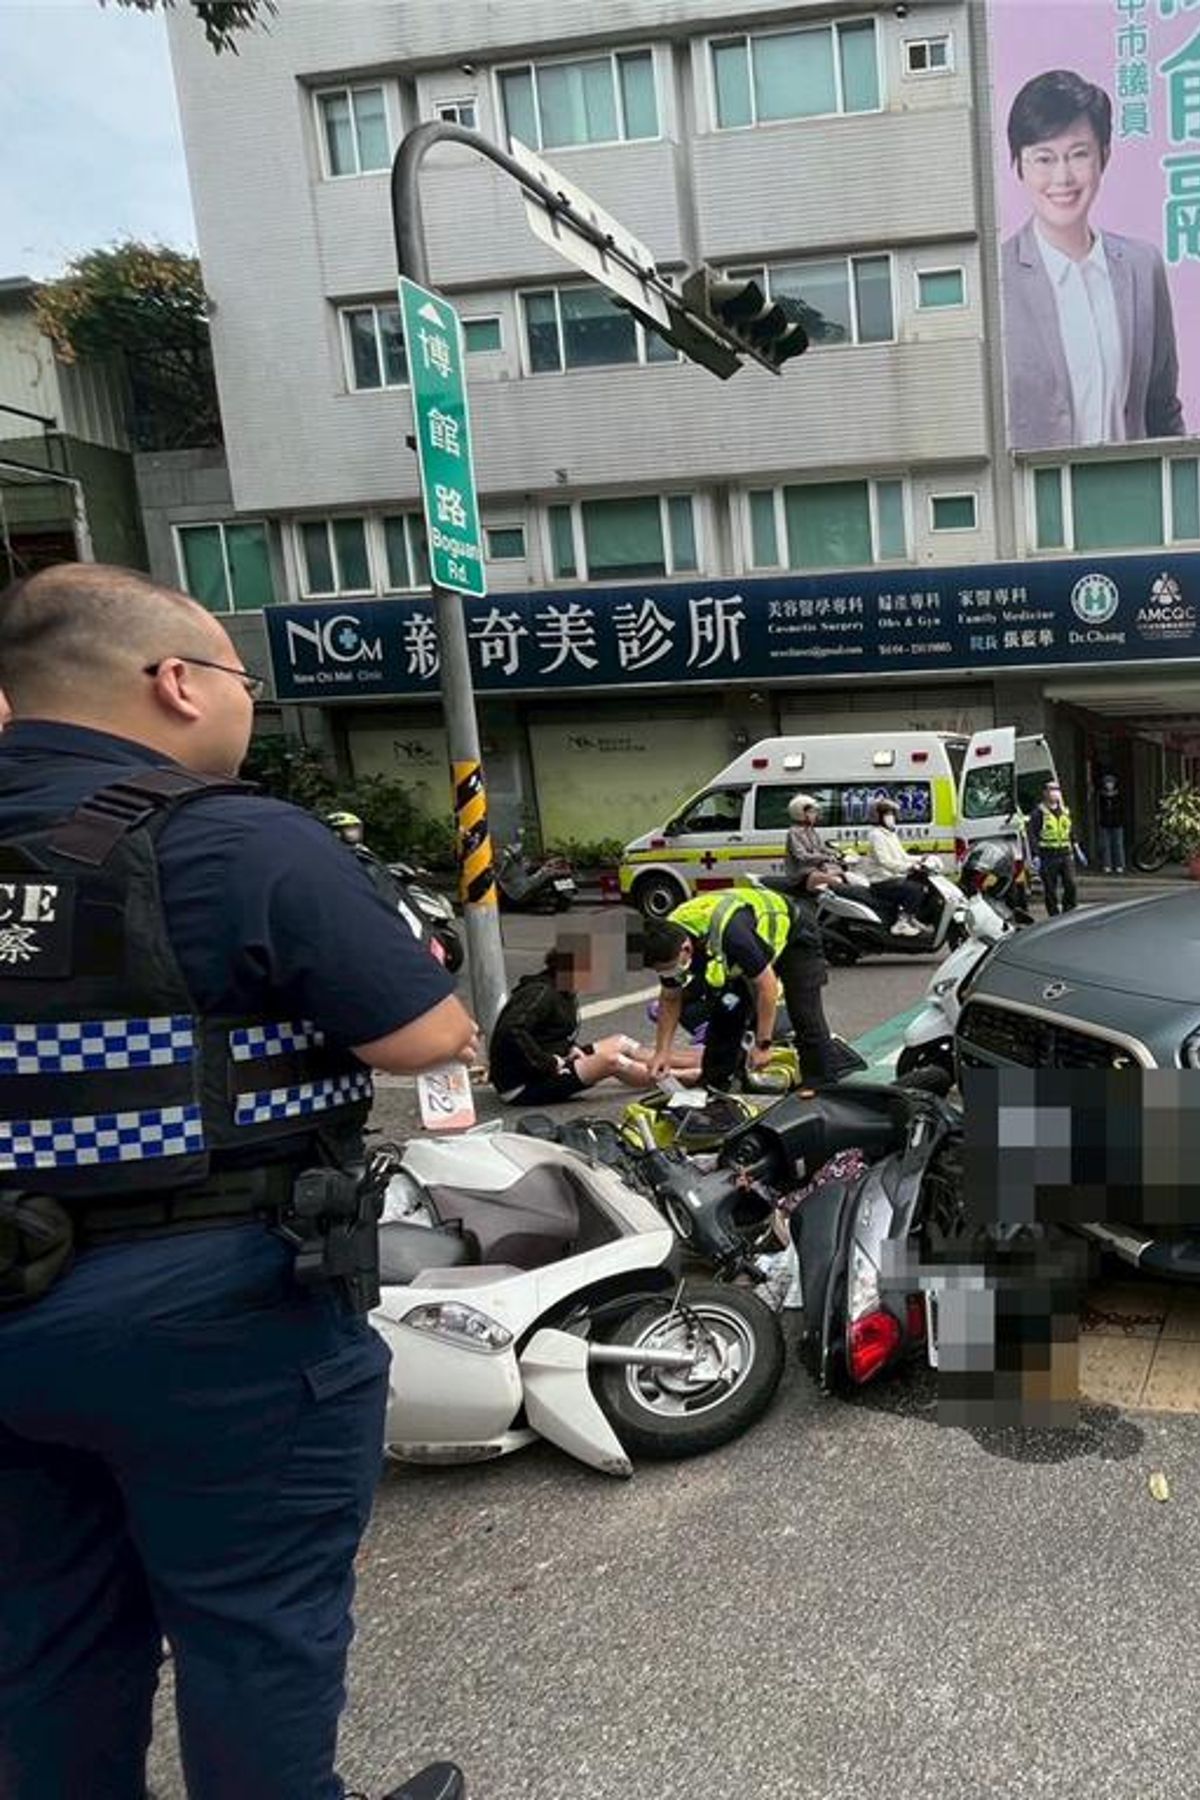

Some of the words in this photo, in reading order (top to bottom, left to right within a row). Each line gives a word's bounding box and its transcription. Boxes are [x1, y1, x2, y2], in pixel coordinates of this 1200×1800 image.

[417, 328, 467, 530] 博館路
[403, 594, 743, 678] 新奇美診所
